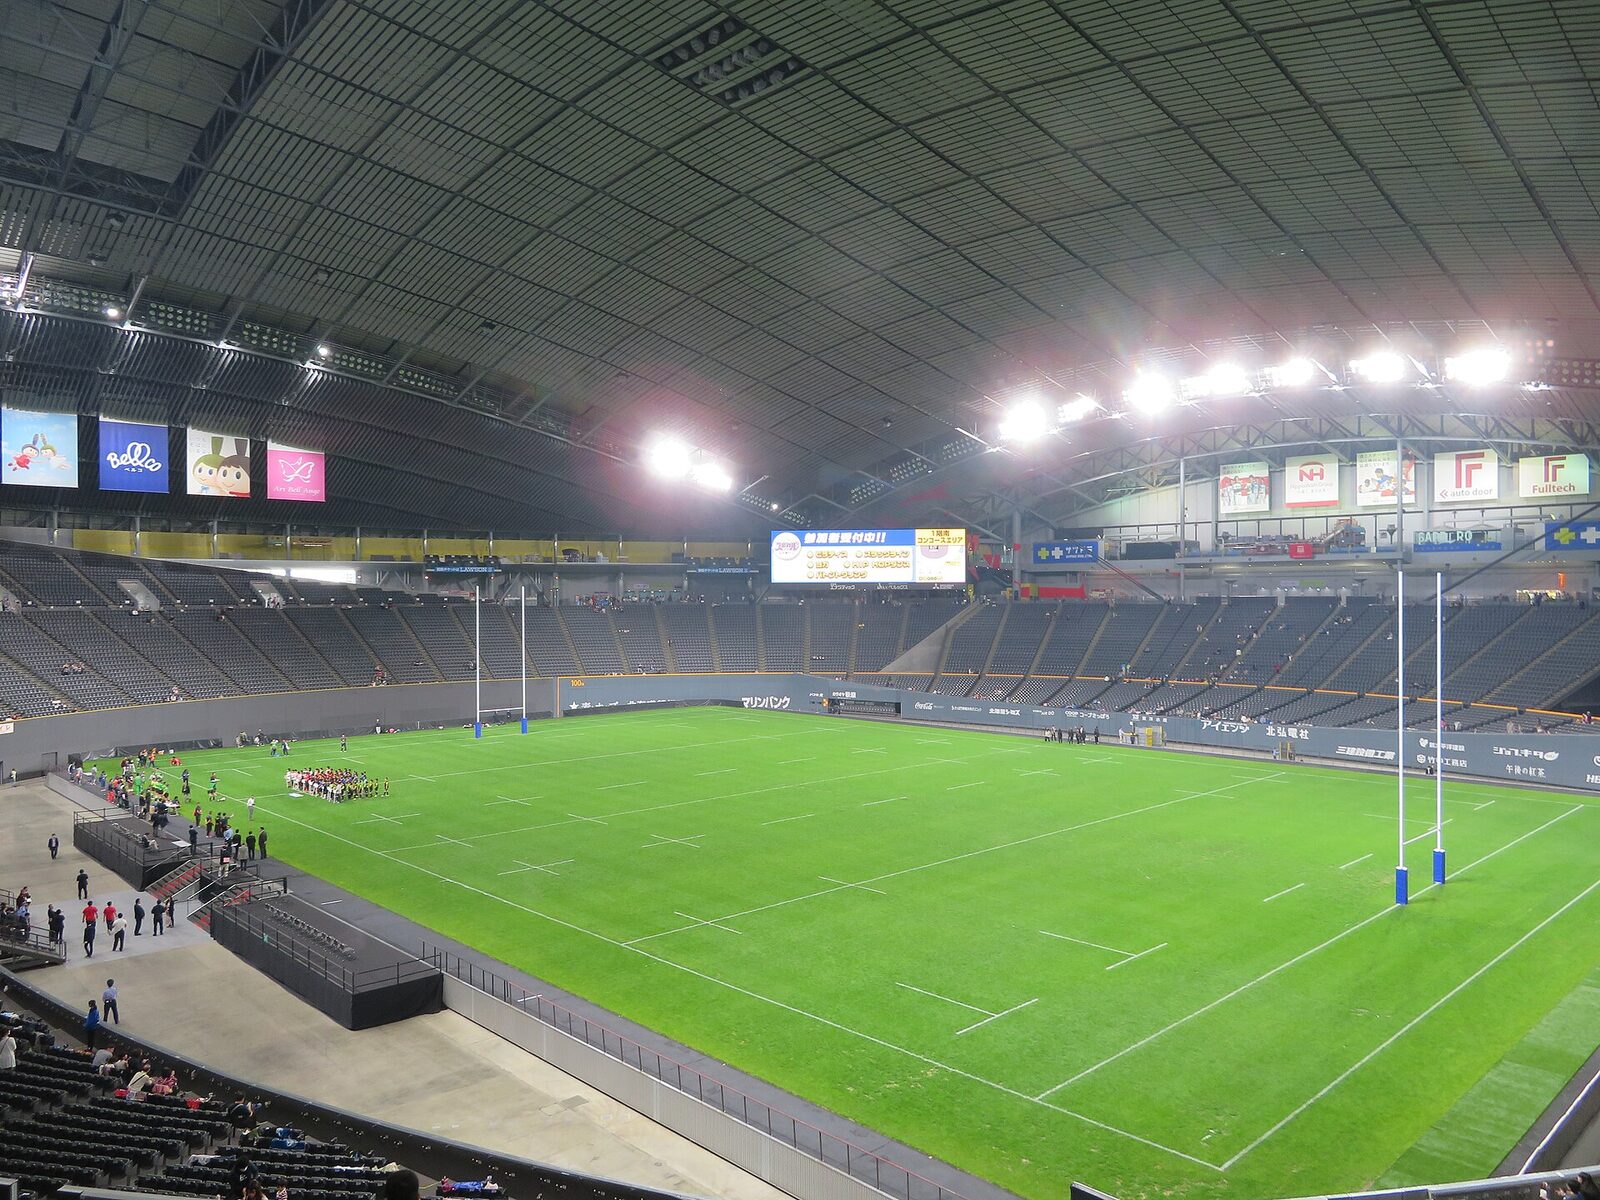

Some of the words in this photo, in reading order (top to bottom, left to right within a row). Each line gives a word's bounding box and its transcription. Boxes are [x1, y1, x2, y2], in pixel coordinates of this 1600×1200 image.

[1450, 488, 1470, 497] auto
[1472, 487, 1493, 496] door
[1532, 483, 1575, 494] Fulltech
[742, 695, 791, 708] マリンバンク
[1266, 725, 1309, 739] 北弘電社
[1505, 764, 1546, 778] 午後の紅茶
